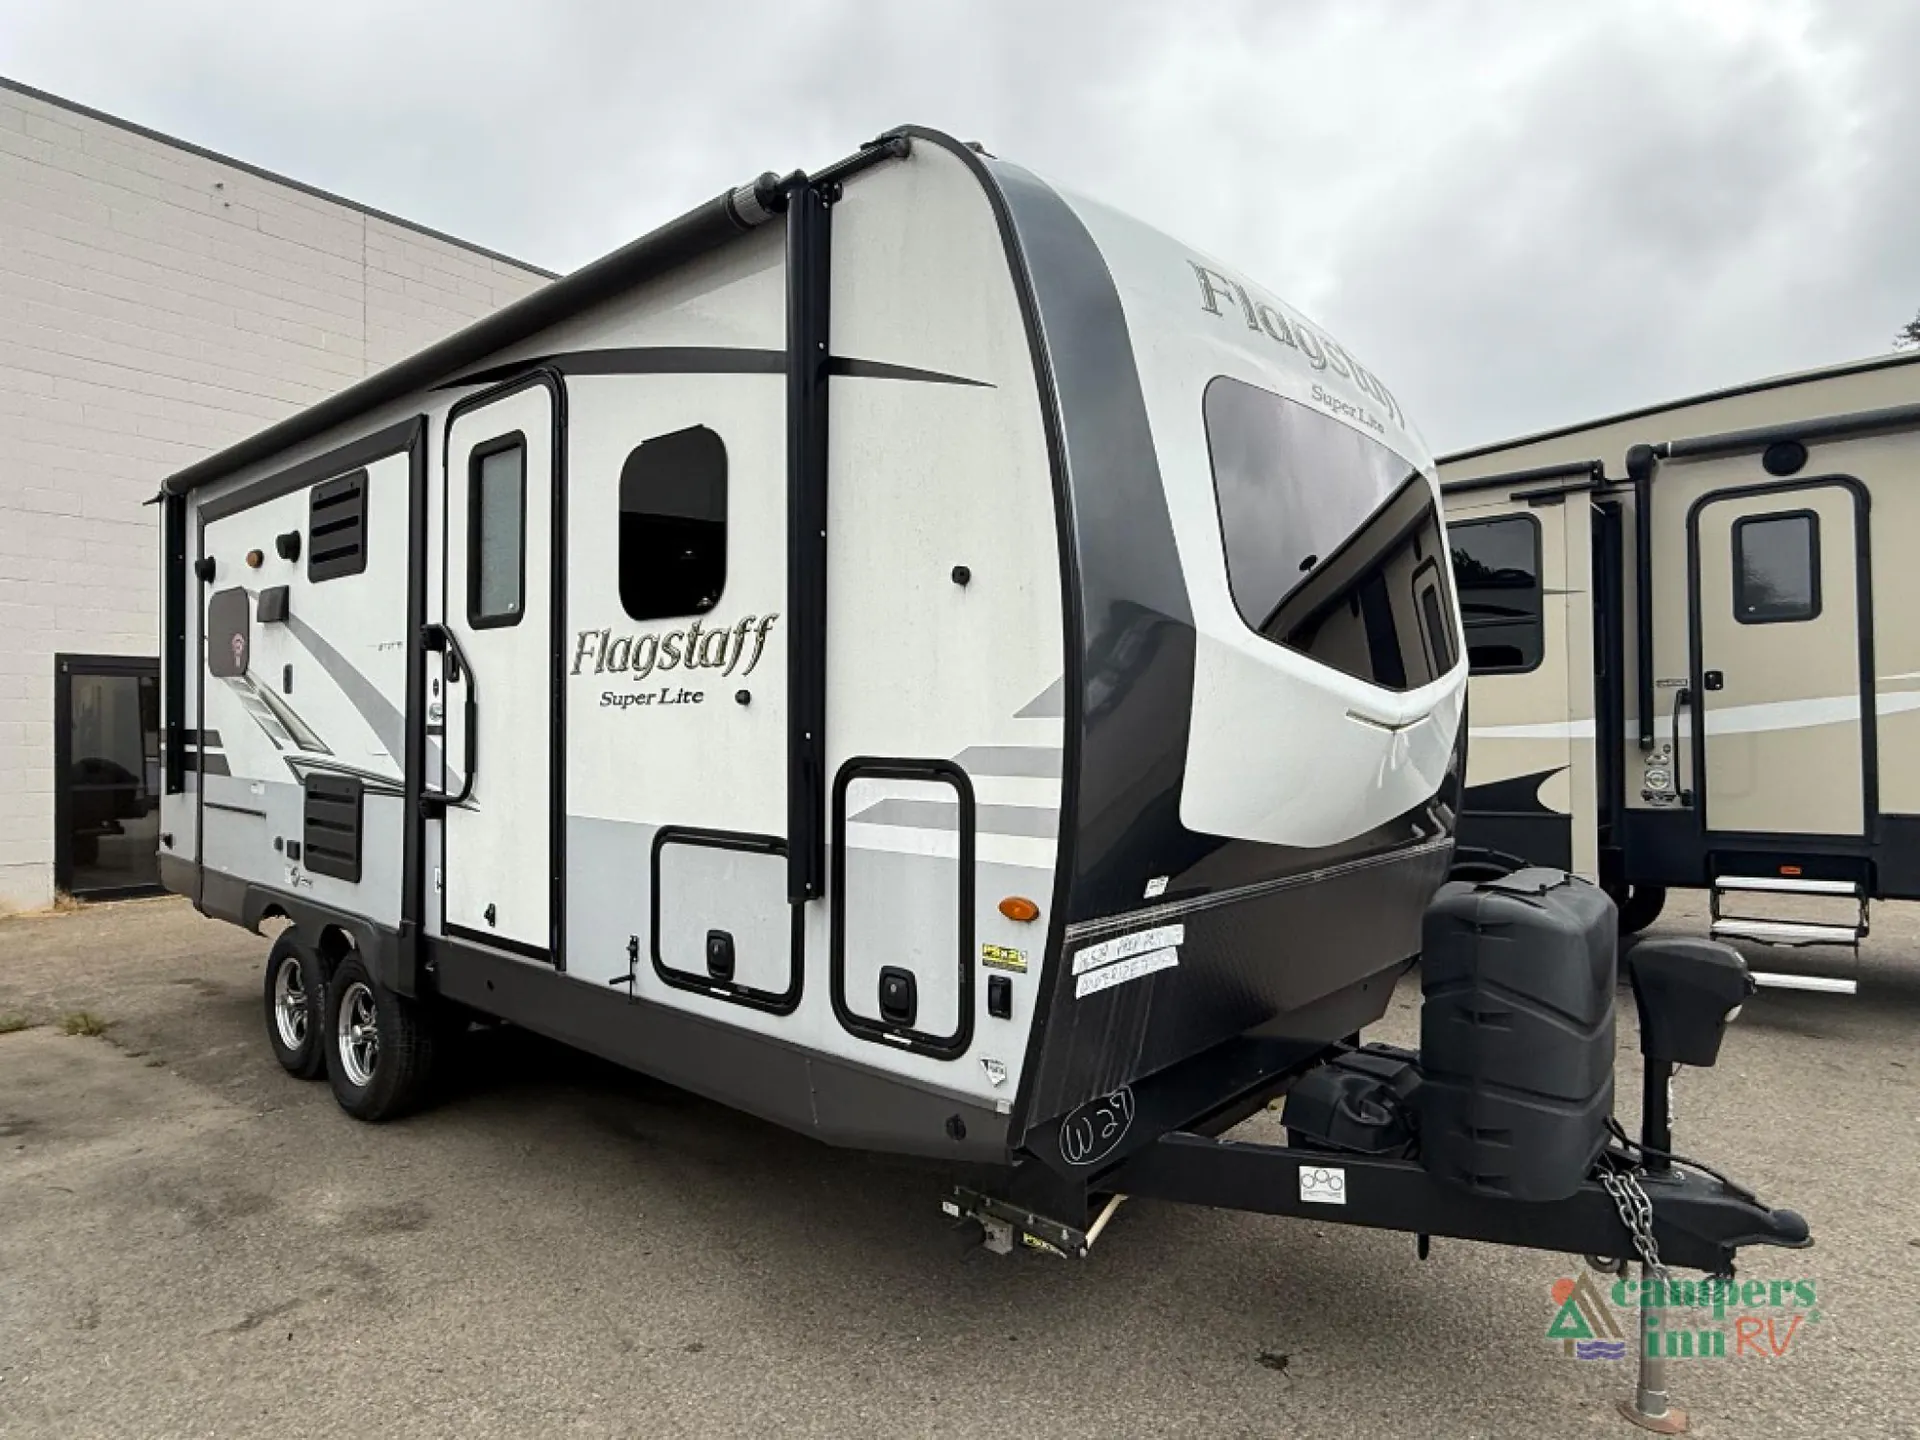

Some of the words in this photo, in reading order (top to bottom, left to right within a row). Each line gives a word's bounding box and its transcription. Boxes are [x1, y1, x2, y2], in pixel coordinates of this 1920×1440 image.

[570, 613, 780, 681] Flagstaff
[600, 691, 656, 709] Super
[658, 687, 704, 704] Lite
